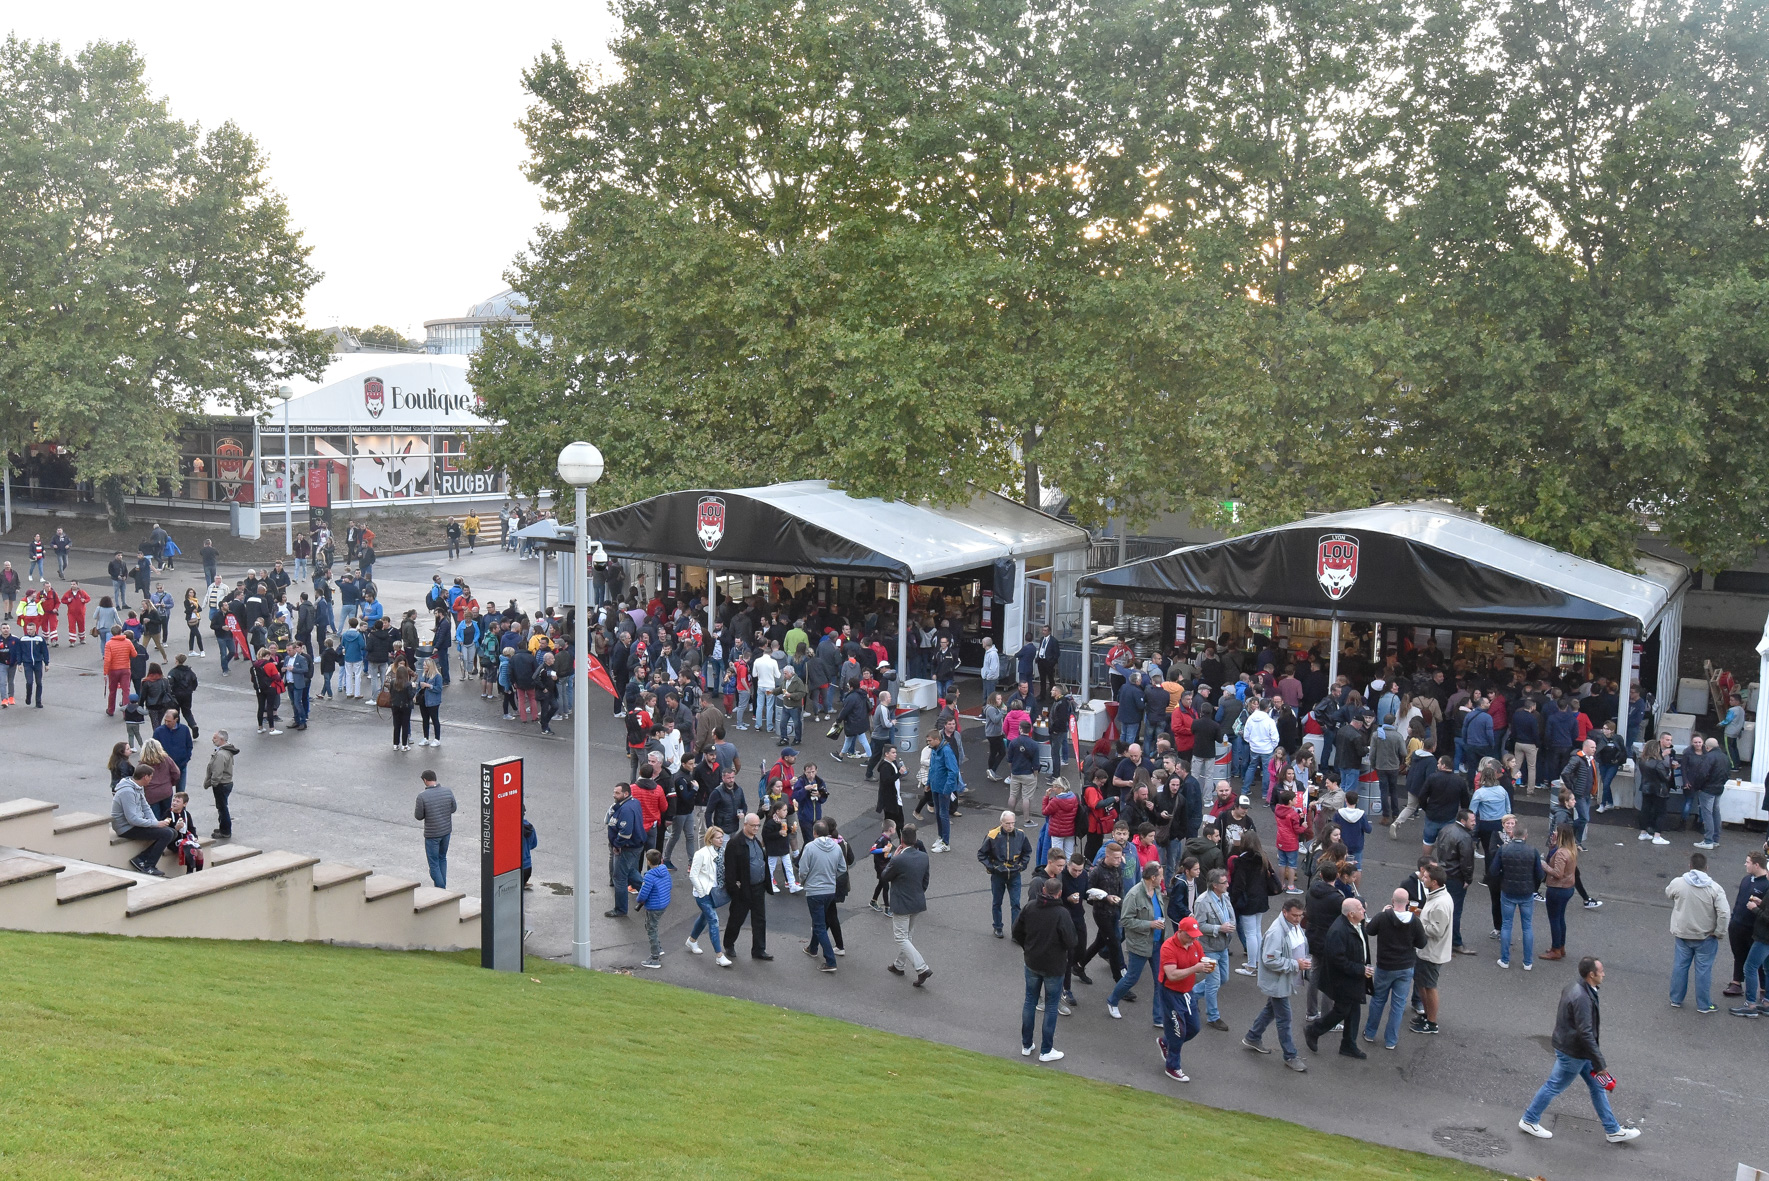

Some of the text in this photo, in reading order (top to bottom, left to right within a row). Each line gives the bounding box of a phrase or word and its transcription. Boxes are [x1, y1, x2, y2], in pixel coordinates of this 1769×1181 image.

[366, 384, 382, 393] LOU
[391, 386, 470, 416] Boutique
[442, 474, 494, 494] RUGBY
[701, 505, 722, 517] LOU
[1322, 544, 1355, 559] LOU
[503, 772, 512, 785] D
[497, 791, 509, 799] CLUB
[482, 768, 491, 854] TRIBUNE OUEST
